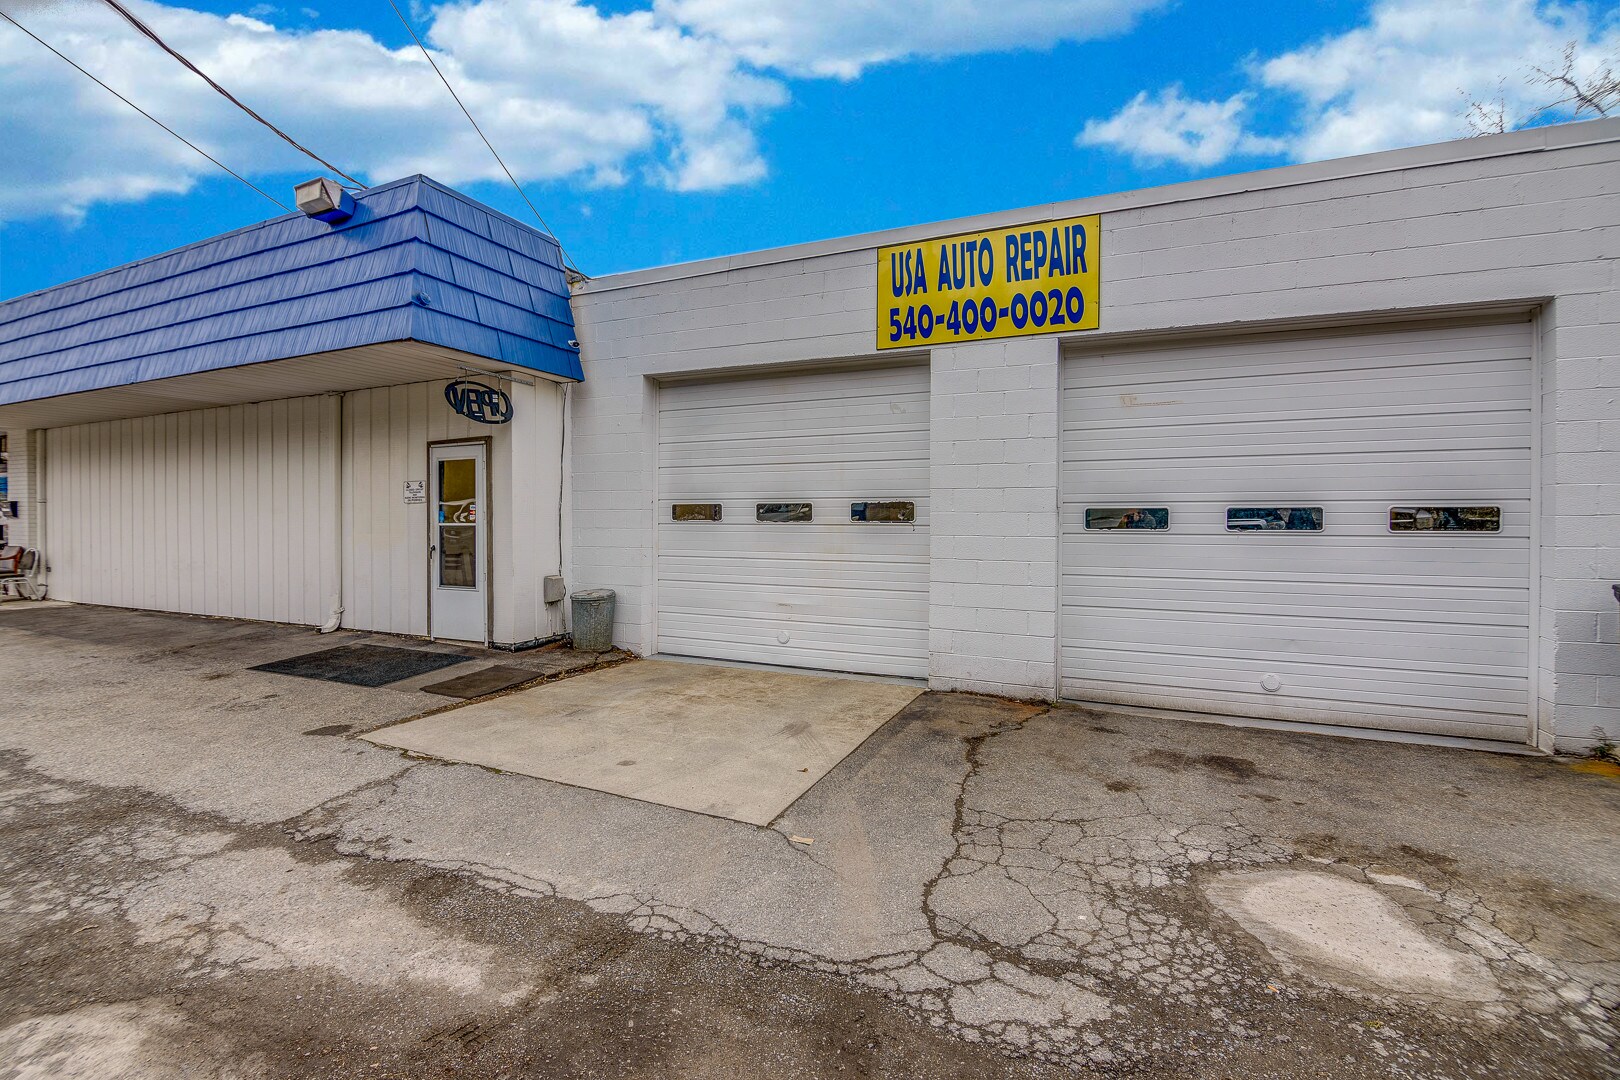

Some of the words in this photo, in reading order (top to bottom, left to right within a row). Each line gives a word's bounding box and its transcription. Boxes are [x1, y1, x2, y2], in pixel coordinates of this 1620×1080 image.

[891, 248, 928, 298] USA
[937, 237, 994, 292] AUTO
[1005, 224, 1088, 283] REPAIR
[889, 286, 1085, 342] 540-400-0020
